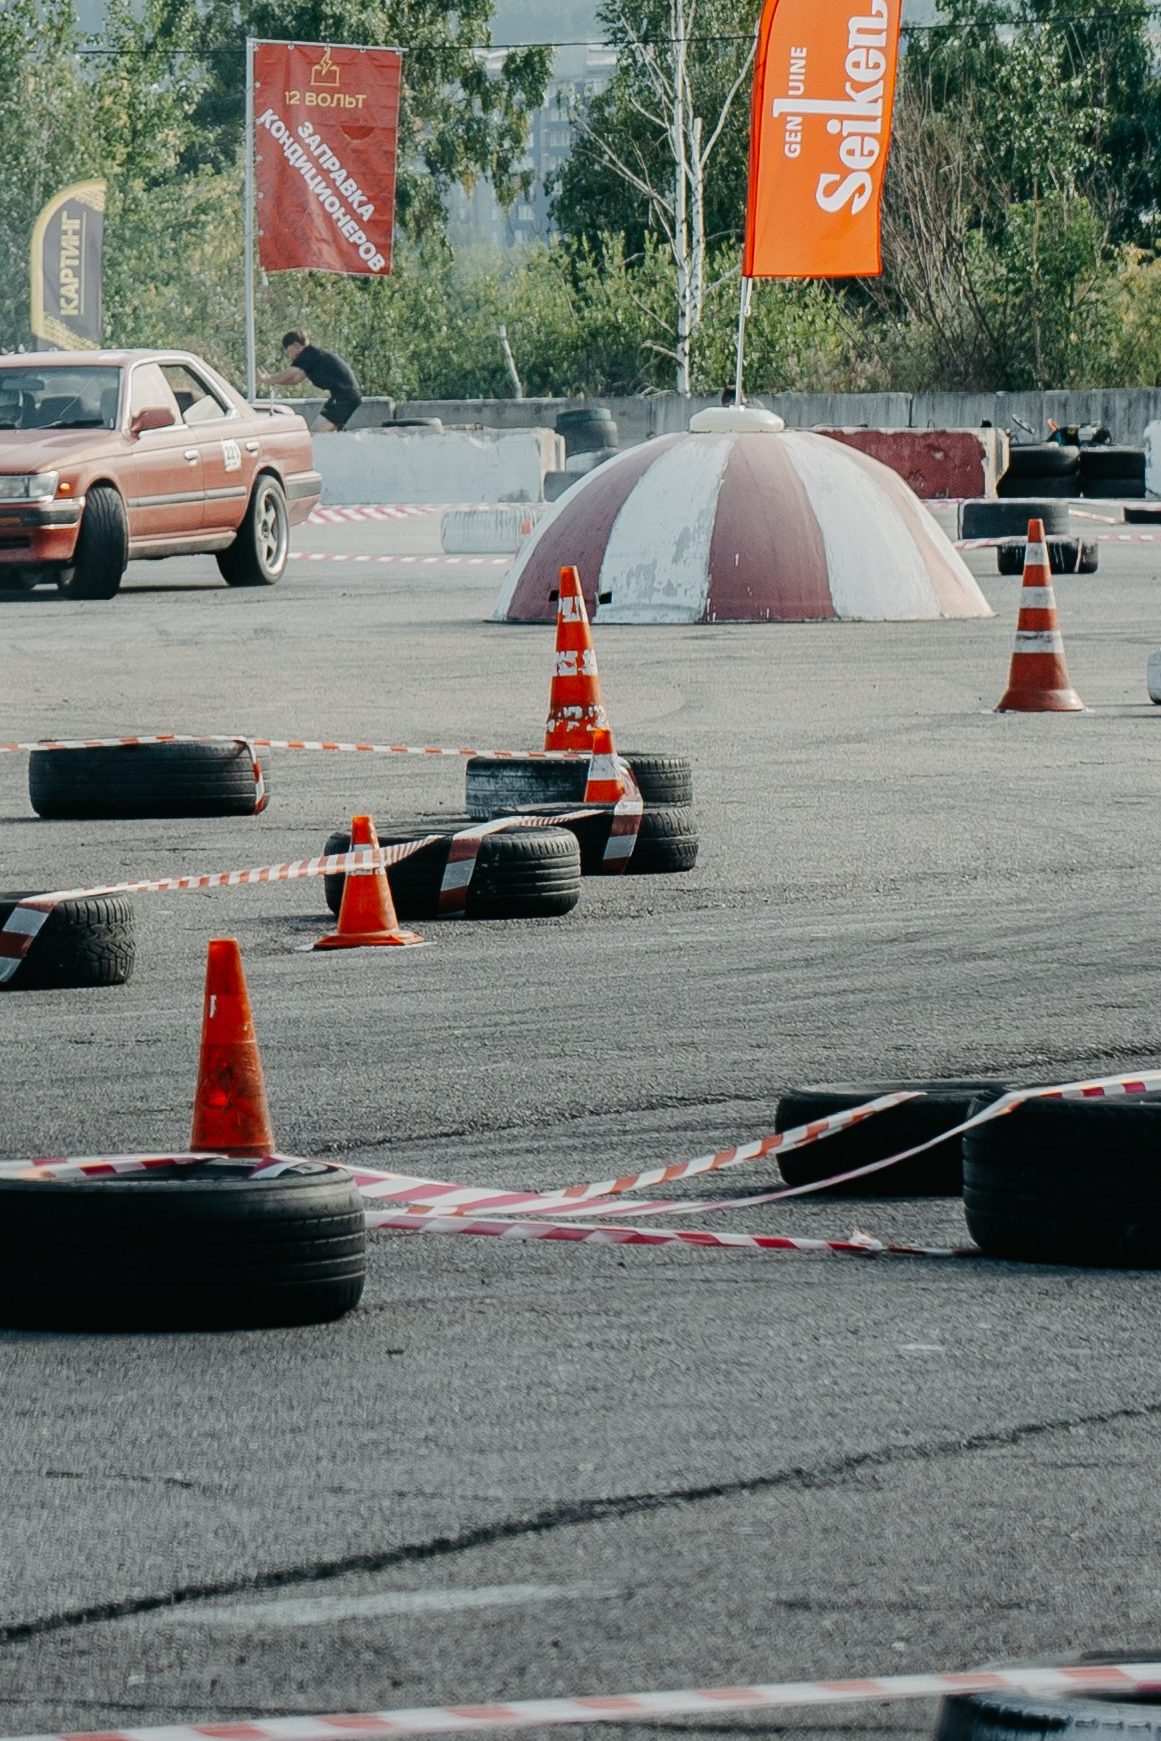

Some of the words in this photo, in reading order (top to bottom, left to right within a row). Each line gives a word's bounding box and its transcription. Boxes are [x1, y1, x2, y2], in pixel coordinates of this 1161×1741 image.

[285, 91, 300, 105] 12
[305, 93, 367, 109] ВОЛЬТ
[256, 108, 386, 272] КОНДИЦИОНЕРОВ
[297, 121, 375, 223] ЗАПРАВКА
[60, 210, 81, 316] КАРТИНГ
